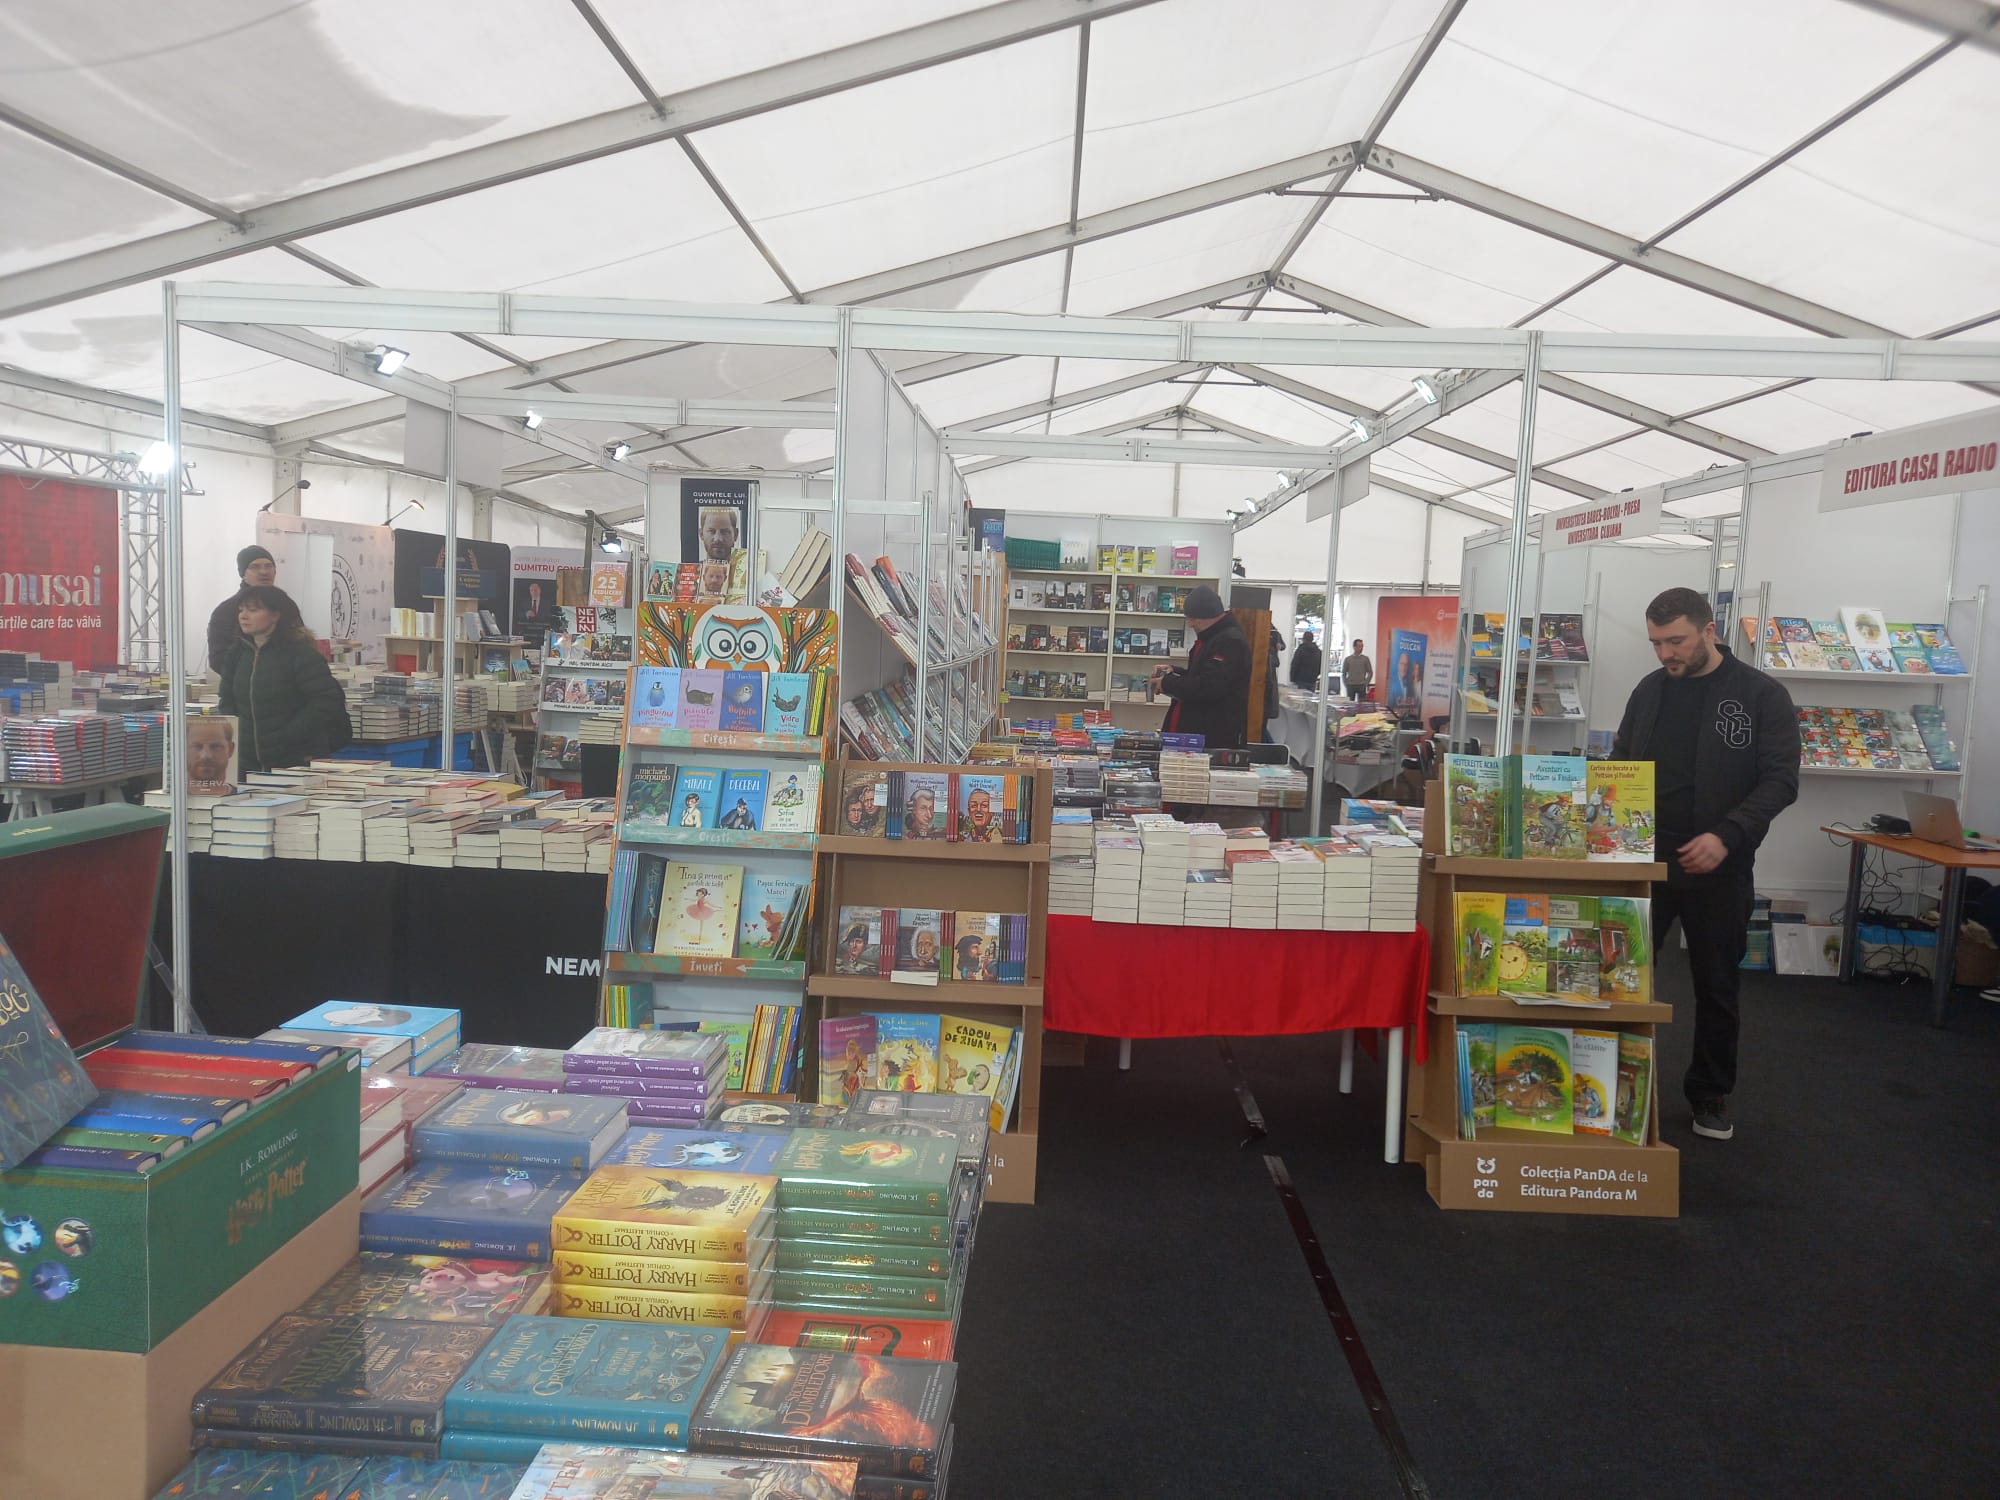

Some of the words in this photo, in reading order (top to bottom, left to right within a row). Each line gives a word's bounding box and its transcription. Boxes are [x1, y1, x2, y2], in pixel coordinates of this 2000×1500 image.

[1844, 460, 1897, 494] EDITURA
[1900, 452, 1938, 484] CASA
[1943, 442, 1997, 477] RADIO
[514, 563, 555, 572] DUMITRU
[0, 565, 101, 607] musai
[0, 616, 28, 632] ărțile
[31, 619, 55, 629] care
[57, 615, 73, 629] fac
[77, 615, 102, 628] vâlvă
[635, 774, 671, 783] morpurgo
[640, 765, 668, 775] michael
[956, 1025, 991, 1039] CADOU
[945, 1032, 958, 1042] DE
[959, 1036, 984, 1049] ZIUA
[985, 1041, 998, 1052] TA
[257, 1128, 298, 1162] ROWLING
[522, 1155, 550, 1164] ROWLING
[1473, 1178, 1498, 1188] pan
[1520, 1166, 1571, 1182] Colecția
[1574, 1168, 1617, 1181] PanDA
[1619, 1170, 1634, 1182] de
[1637, 1170, 1648, 1183] la
[879, 1192, 907, 1200] ROWLING
[1477, 1188, 1494, 1198] da
[1520, 1184, 1567, 1198] Editura
[1570, 1187, 1622, 1200] Pandora
[1625, 1189, 1637, 1200] M
[474, 1242, 504, 1250] ROWLING
[584, 1232, 641, 1250] POTTER
[646, 1236, 696, 1254] HARRY
[880, 1257, 908, 1265] ROWLING
[585, 1265, 642, 1283] POTTER
[647, 1269, 697, 1287] HARRY
[878, 1286, 905, 1294] ROWLING
[585, 1299, 640, 1318] POTTER
[646, 1303, 696, 1321] HARRY
[497, 1329, 539, 1369] ROWLING
[709, 1382, 728, 1409] ROWLING
[781, 1352, 835, 1427] DUMBLEDORE
[319, 1415, 369, 1431] ROWLING
[572, 1419, 622, 1432] ROWLING
